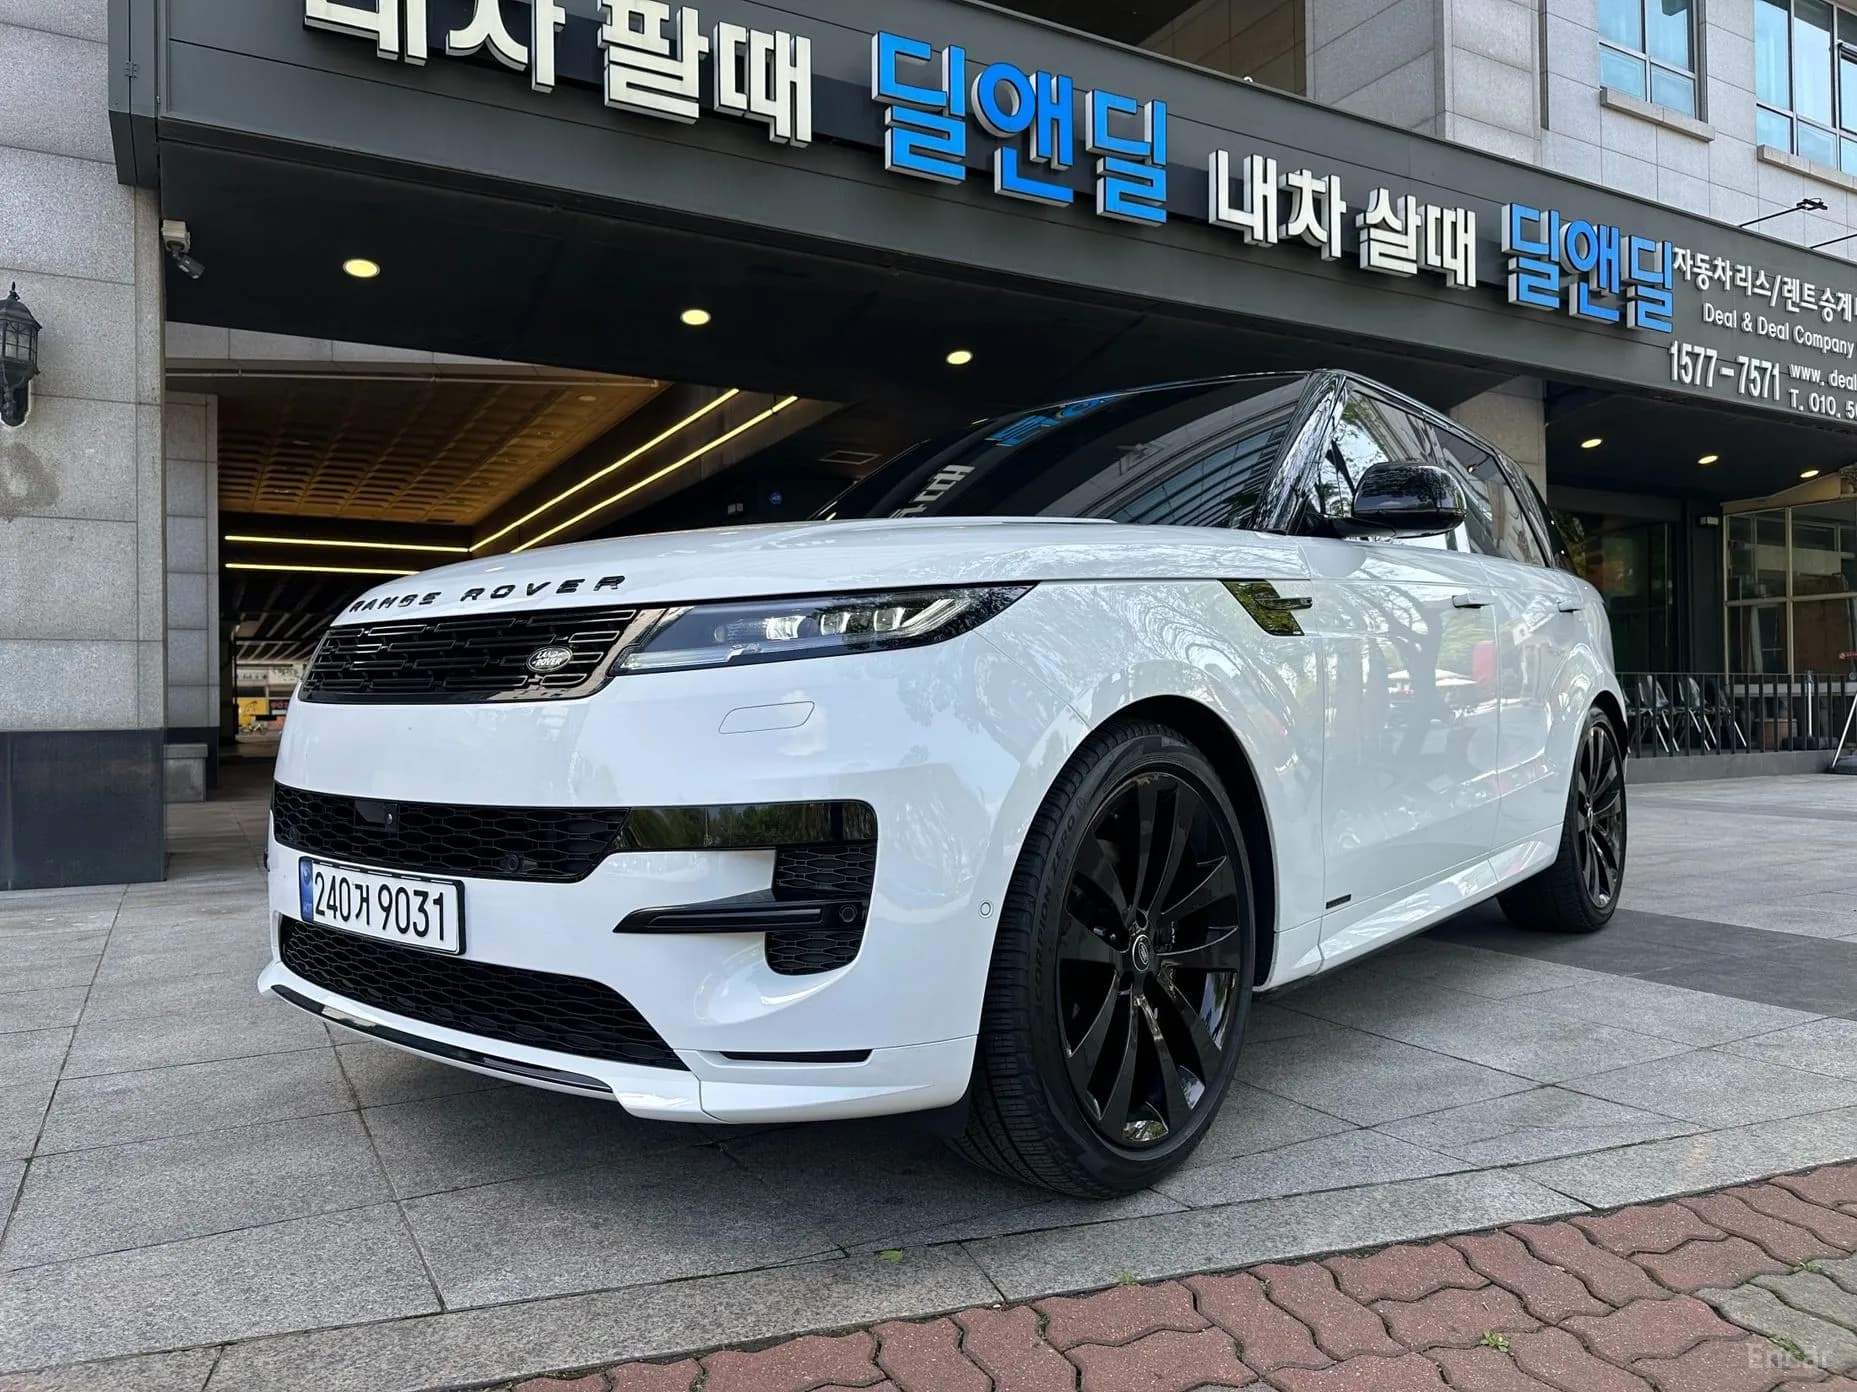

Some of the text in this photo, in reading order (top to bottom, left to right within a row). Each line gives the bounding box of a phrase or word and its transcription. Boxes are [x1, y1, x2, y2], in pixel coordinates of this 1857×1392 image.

[597, 0, 812, 148] 팔때
[871, 31, 1167, 227] 딜앤딜
[1209, 150, 1347, 262] 내차
[1356, 188, 1477, 291] 살때
[1501, 203, 1673, 334] 딜앤딜
[1703, 302, 1855, 359] Deal & Deal Company
[1669, 340, 1780, 400] 1577-7571
[1788, 388, 1804, 411] T.
[349, 575, 626, 613] RANGE ROVER
[314, 871, 445, 941] 240거 9031
